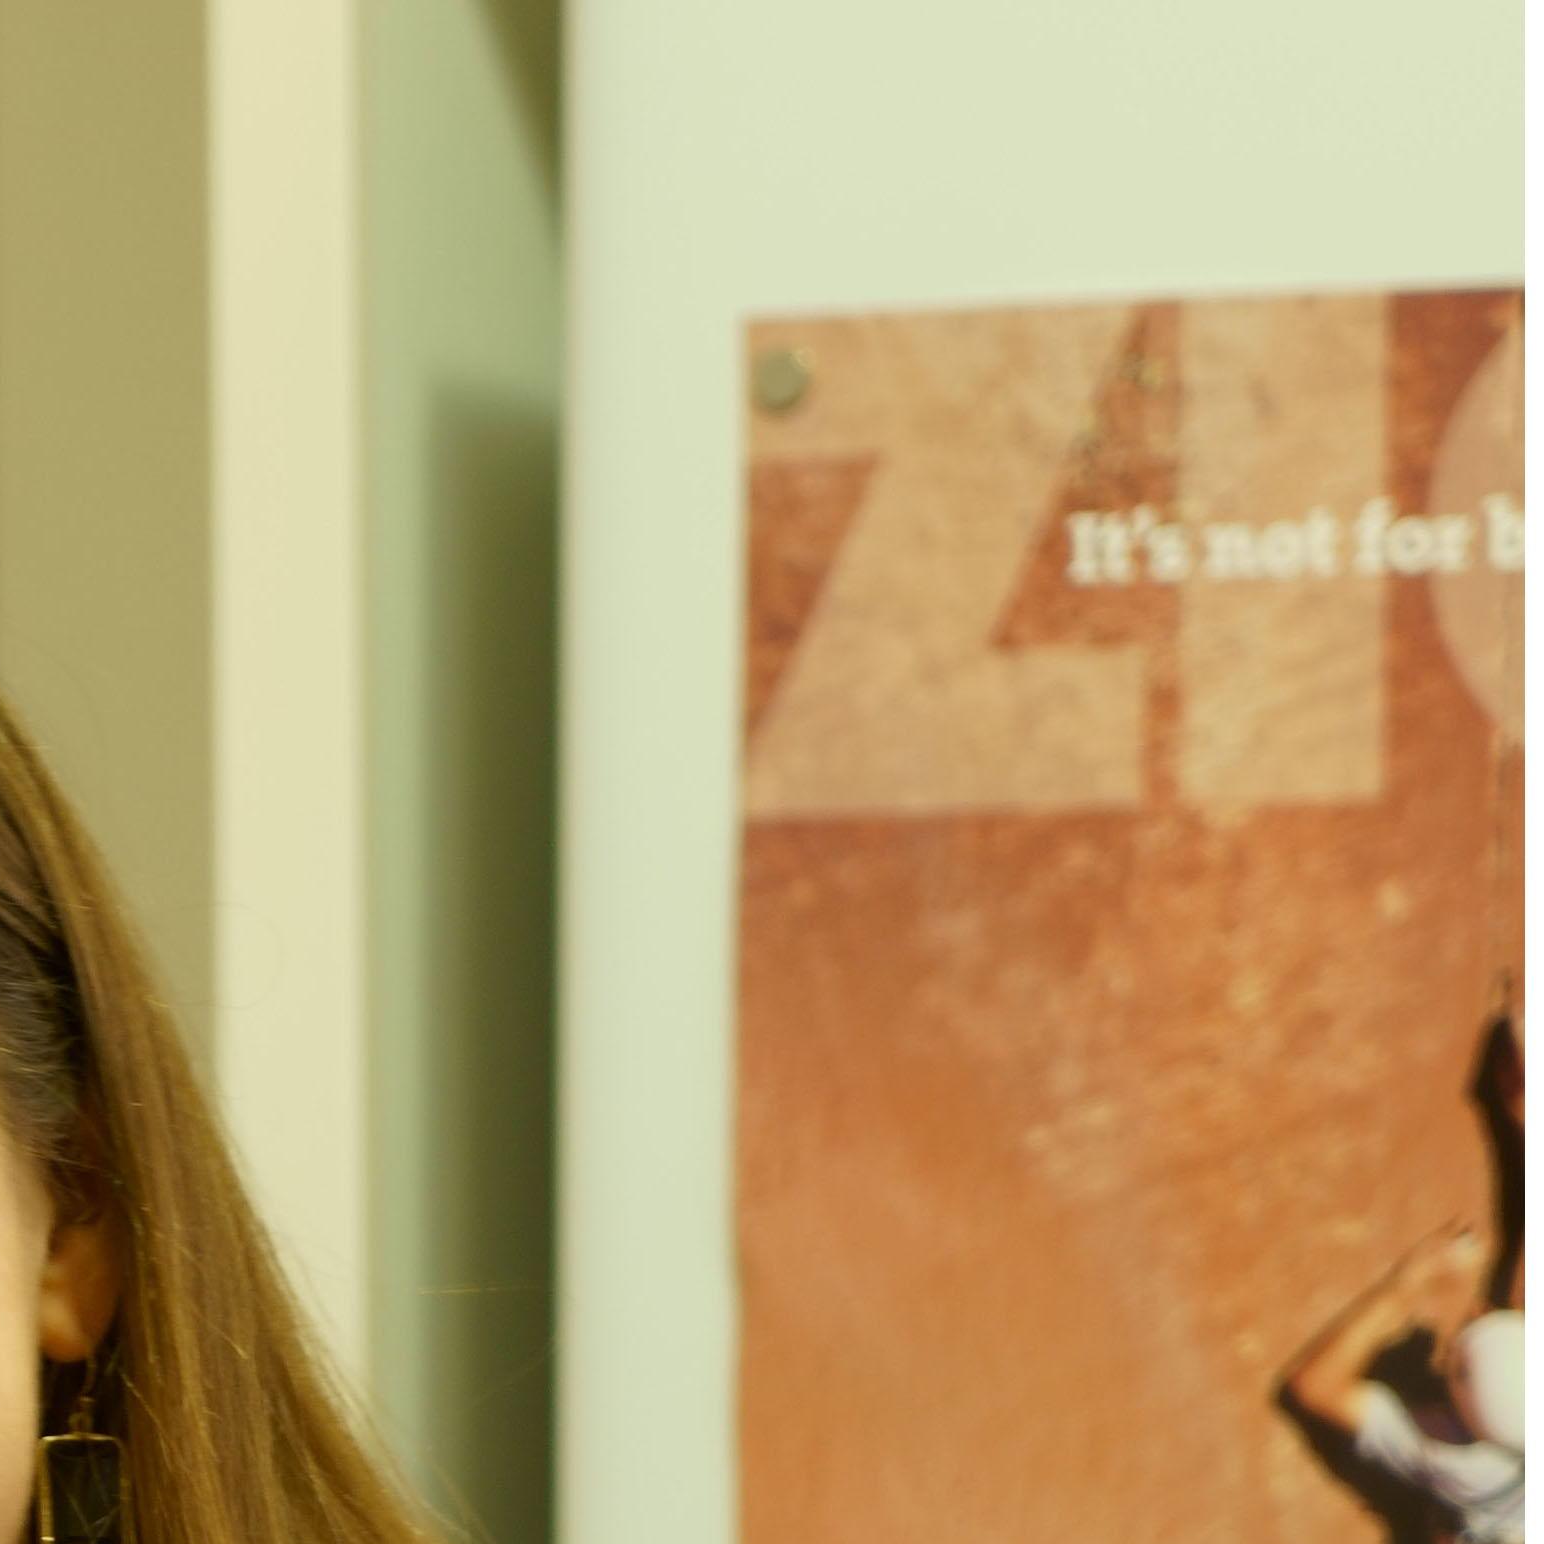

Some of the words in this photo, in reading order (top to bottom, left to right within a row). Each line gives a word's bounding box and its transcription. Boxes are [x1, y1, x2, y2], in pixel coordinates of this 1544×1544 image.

[1067, 504, 1191, 585] It's
[1203, 505, 1339, 581] not
[1356, 495, 1472, 576] for
